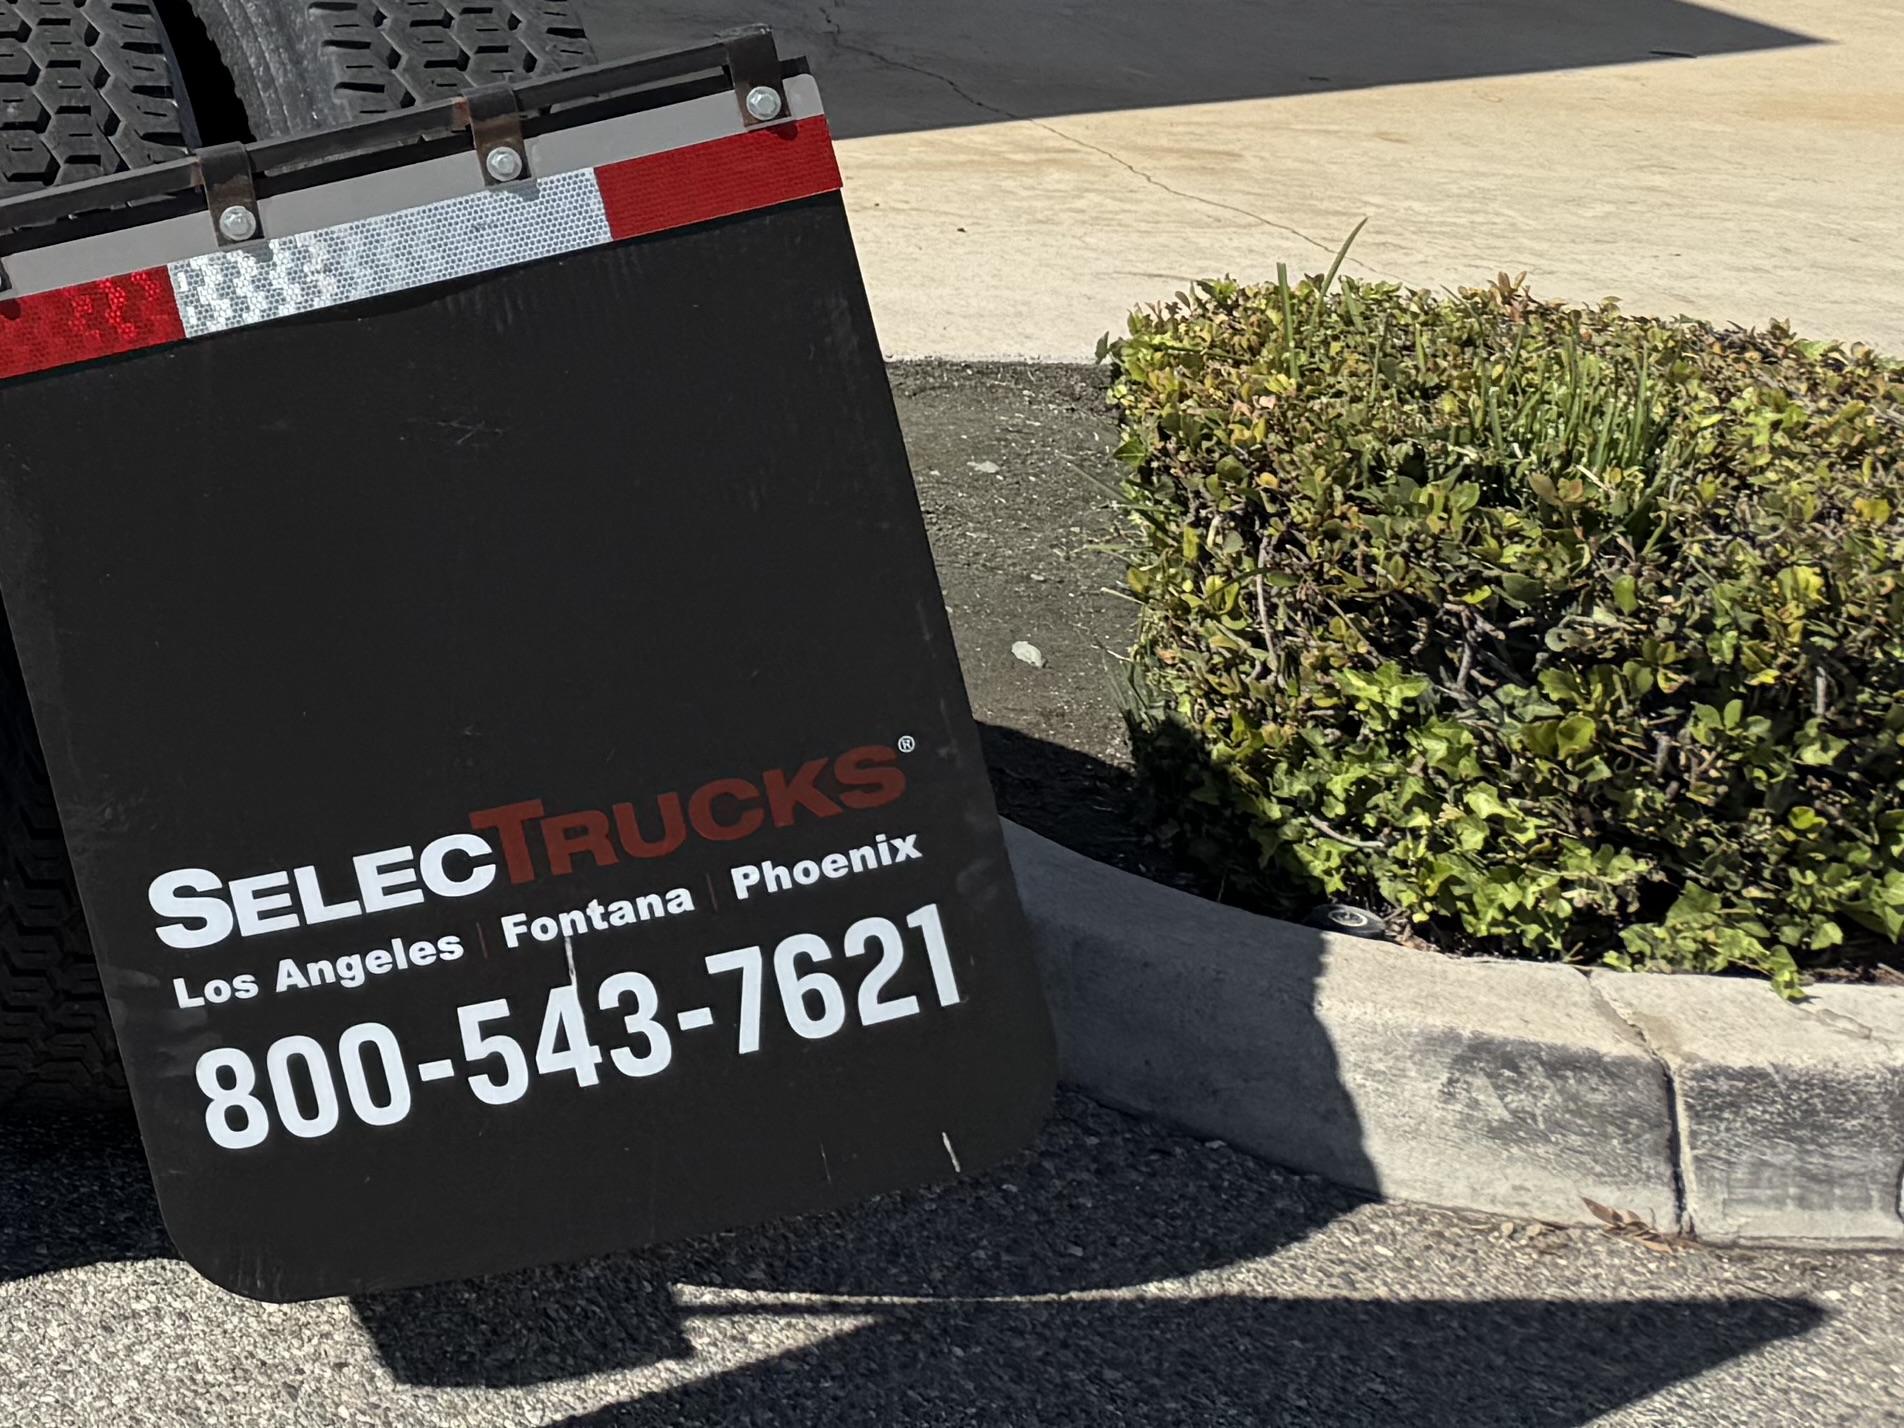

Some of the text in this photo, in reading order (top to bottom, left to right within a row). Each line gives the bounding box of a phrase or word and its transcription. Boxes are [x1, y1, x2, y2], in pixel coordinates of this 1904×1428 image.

[172, 833, 923, 1010] Los Angeles Fontana Phoenix
[195, 903, 961, 1150] 800-543-7621
